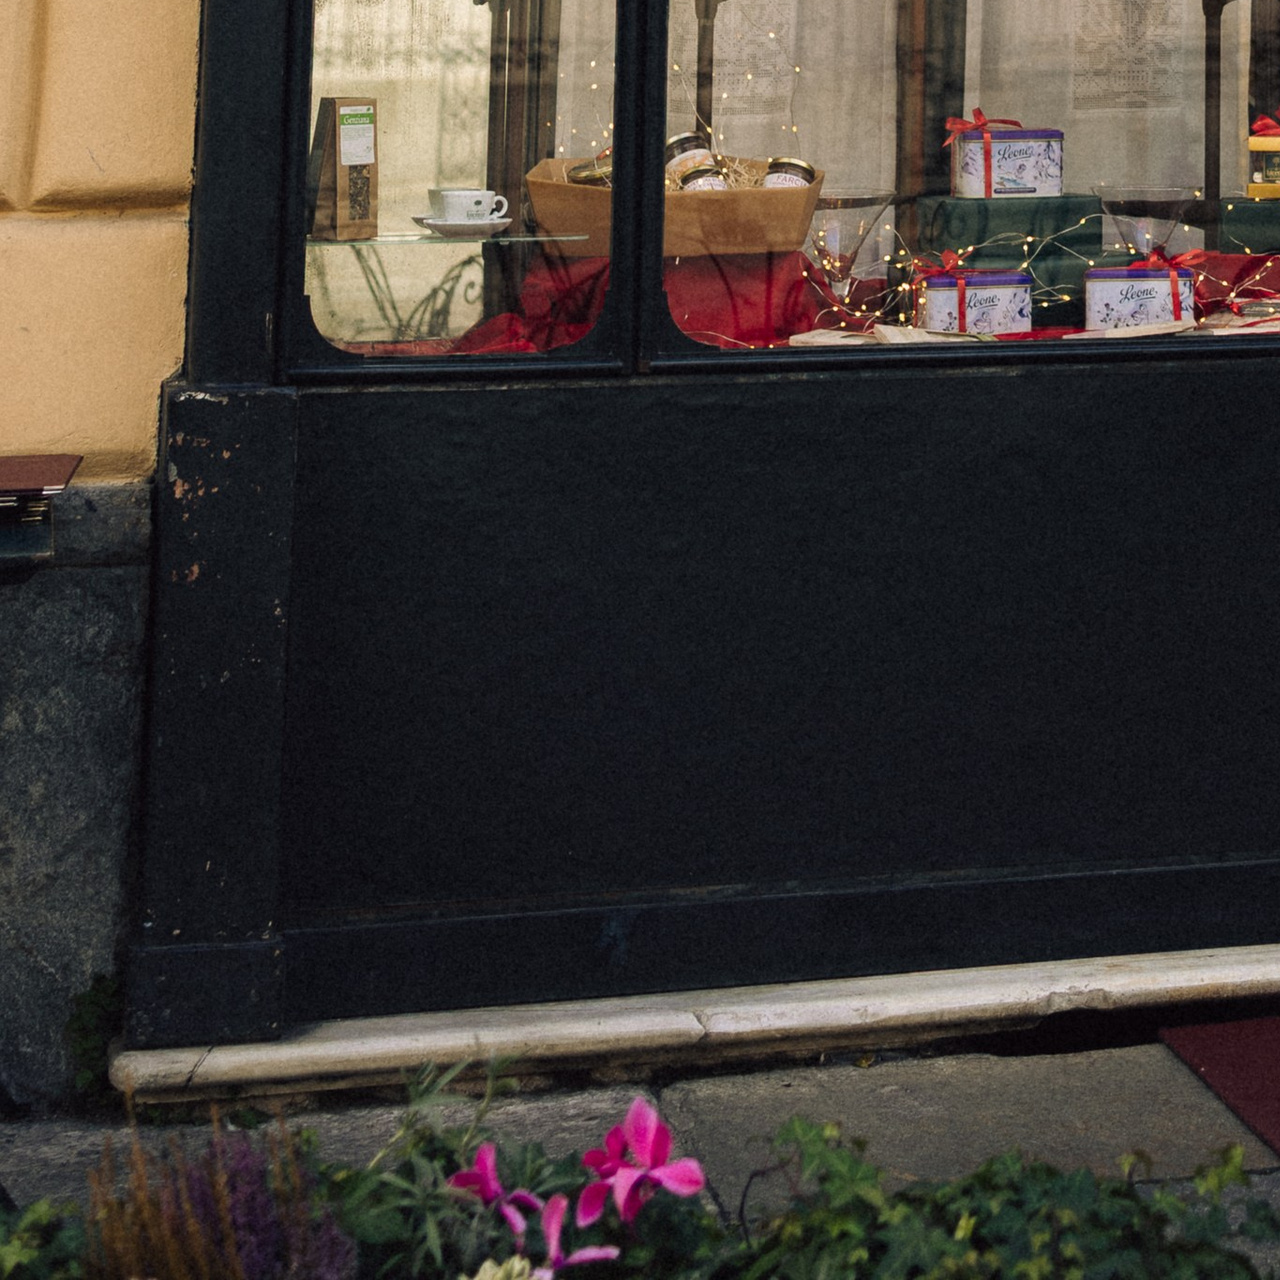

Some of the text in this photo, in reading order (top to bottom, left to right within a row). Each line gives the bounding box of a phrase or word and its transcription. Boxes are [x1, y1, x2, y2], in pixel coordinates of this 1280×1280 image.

[997, 144, 1033, 163] Leone
[966, 291, 1000, 310] Leone
[1119, 283, 1158, 303] Leone
